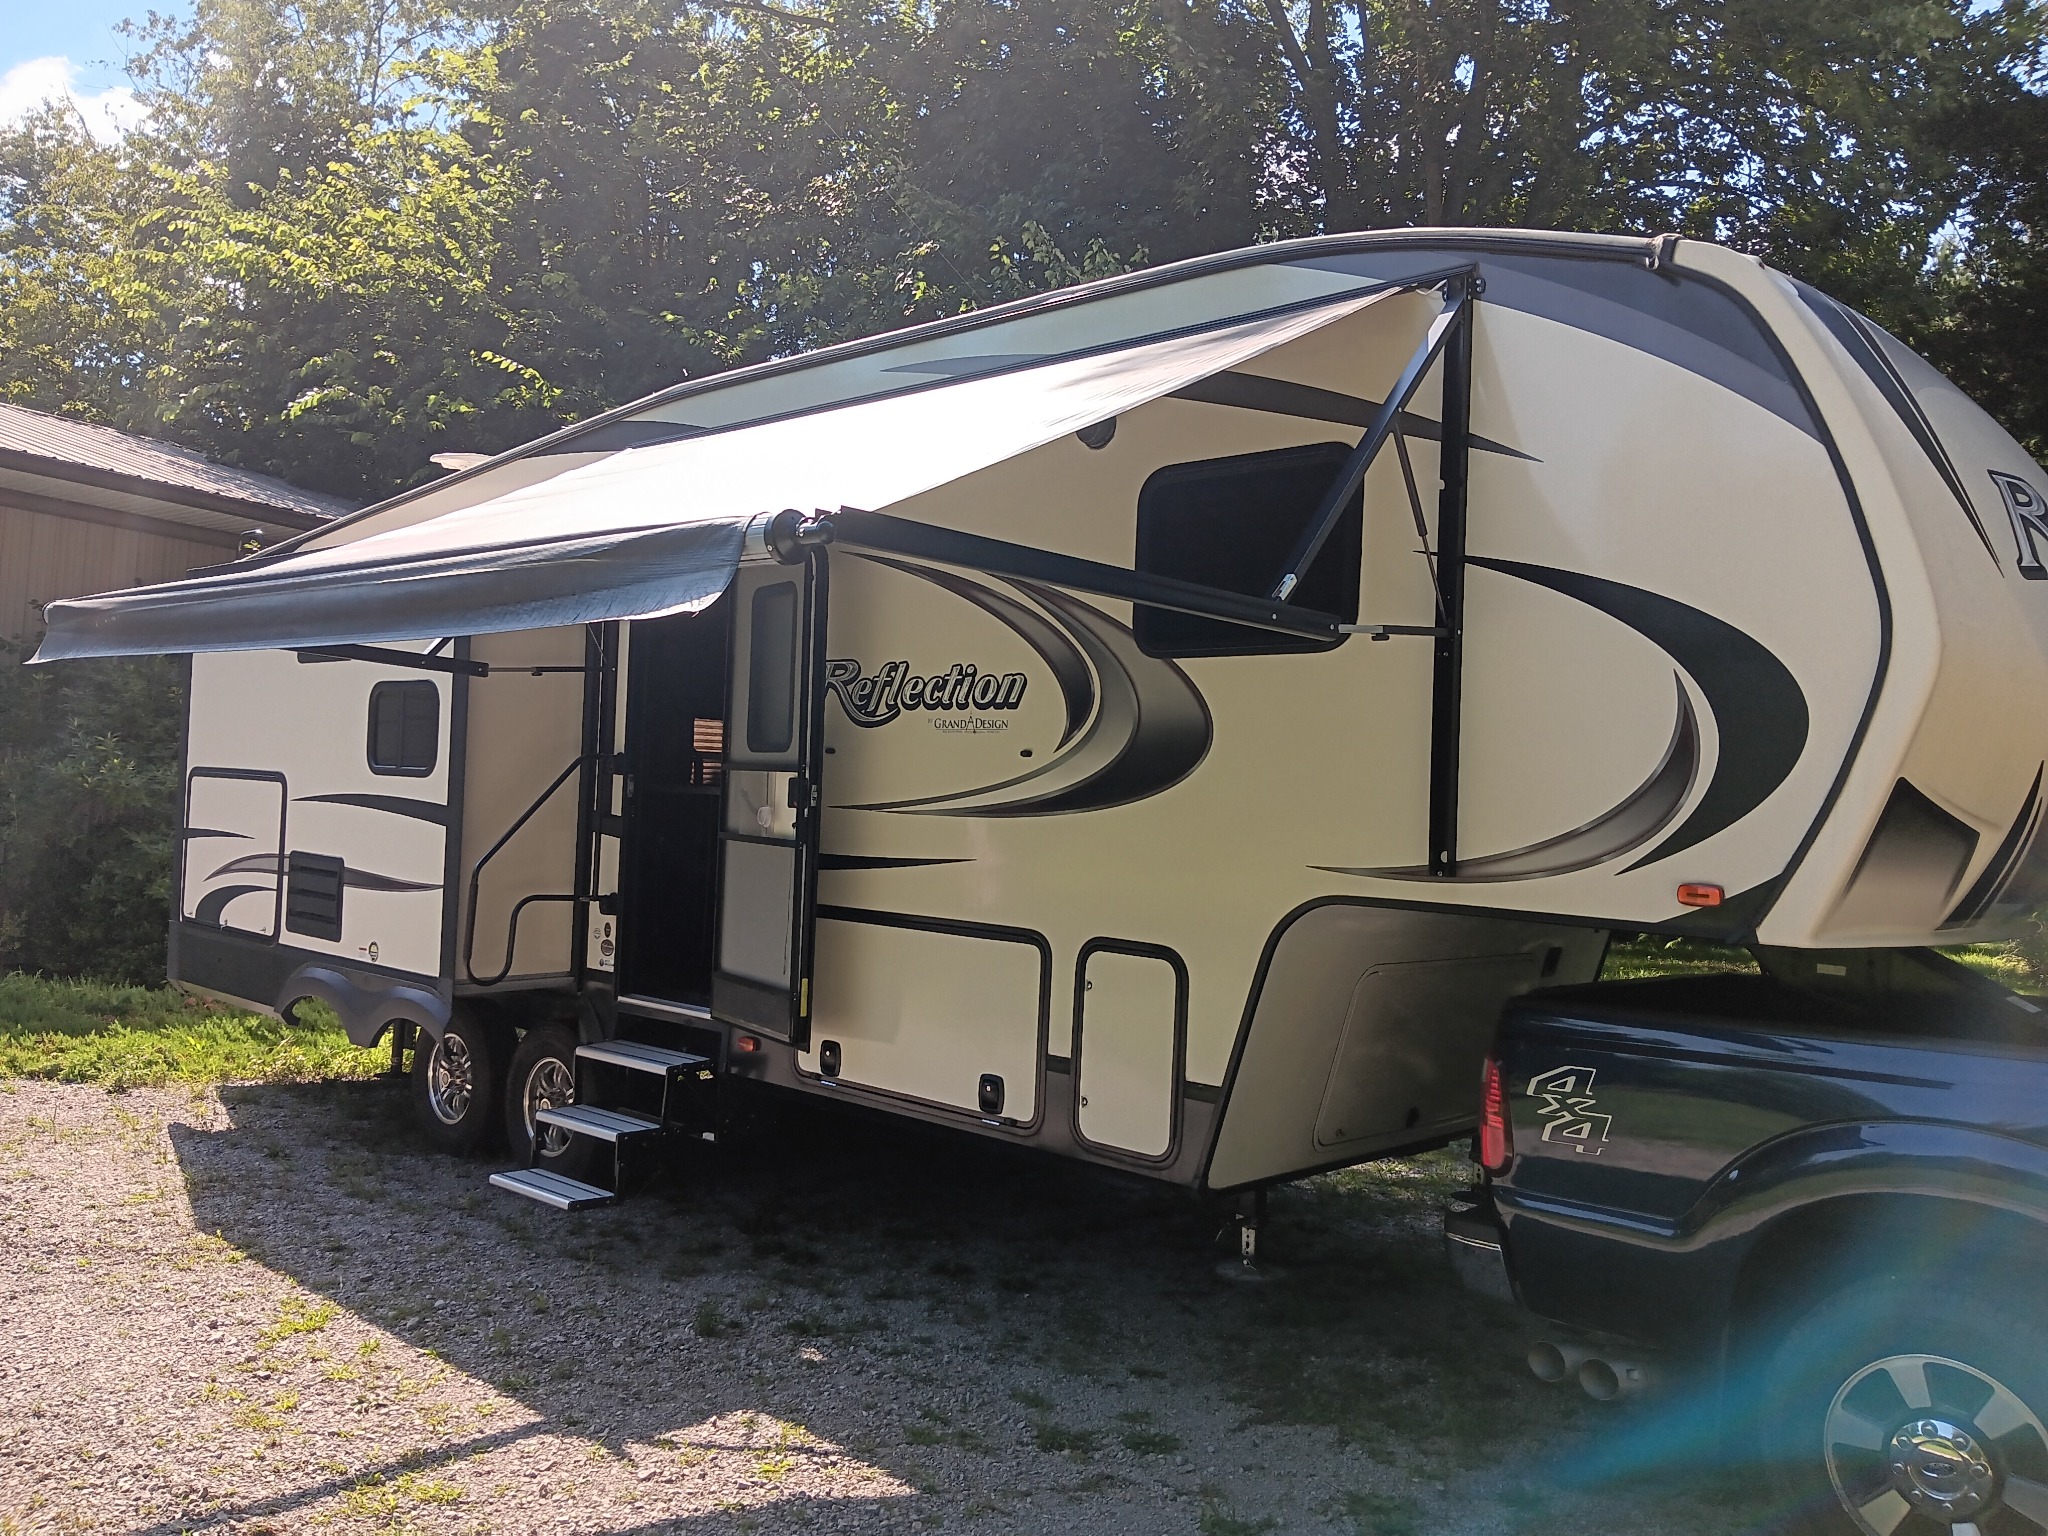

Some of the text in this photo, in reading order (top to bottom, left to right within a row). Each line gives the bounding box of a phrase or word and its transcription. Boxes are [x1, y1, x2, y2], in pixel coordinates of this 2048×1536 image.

[825, 658, 1027, 728] Reflection
[934, 717, 967, 729] GRAND
[975, 717, 1009, 729] DESIGN
